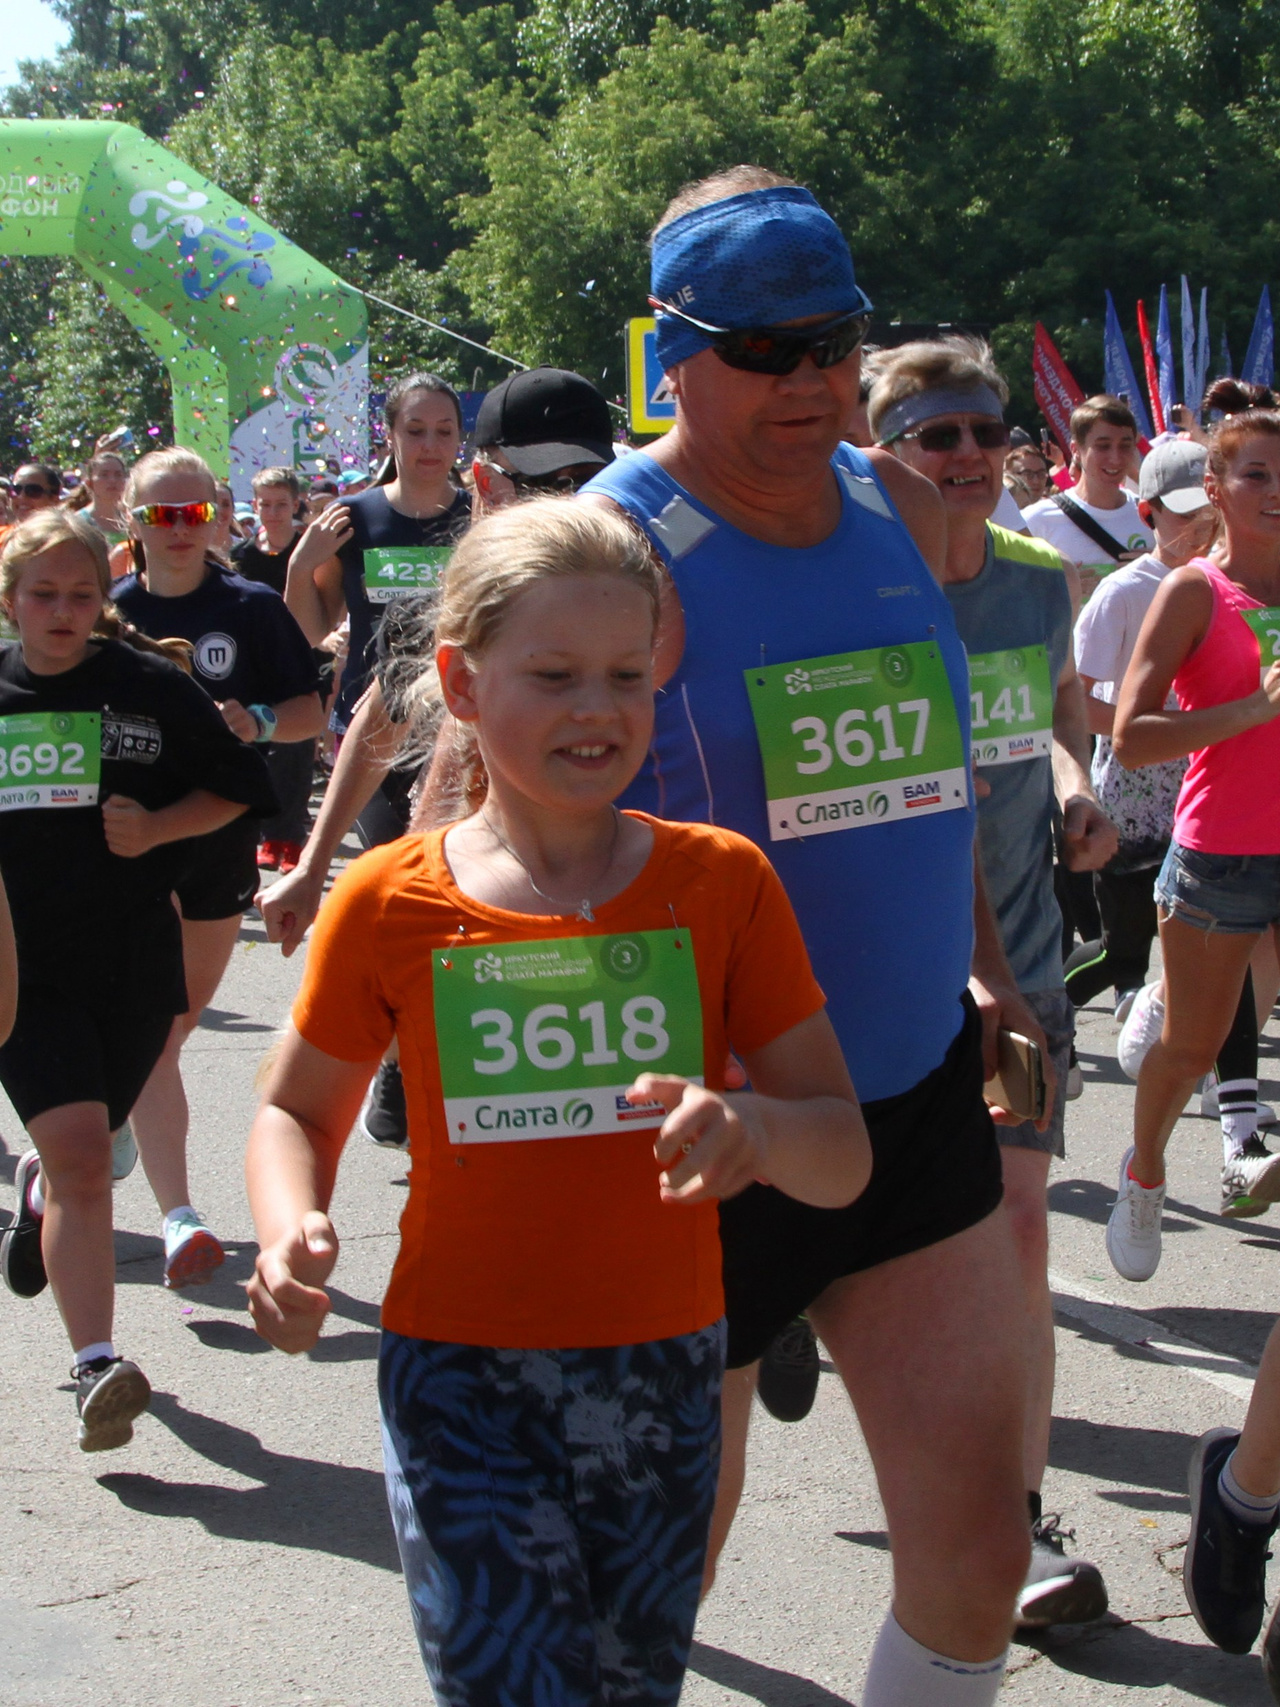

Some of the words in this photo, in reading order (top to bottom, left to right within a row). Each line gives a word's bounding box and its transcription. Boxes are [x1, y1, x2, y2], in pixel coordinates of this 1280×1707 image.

[1, 198, 58, 216] ФОН
[970, 684, 1035, 728] 141
[790, 698, 931, 775] 3617
[796, 799, 864, 825] Слата
[902, 780, 940, 799] БАМ
[470, 995, 670, 1075] 3618
[475, 1104, 558, 1130] Слата
